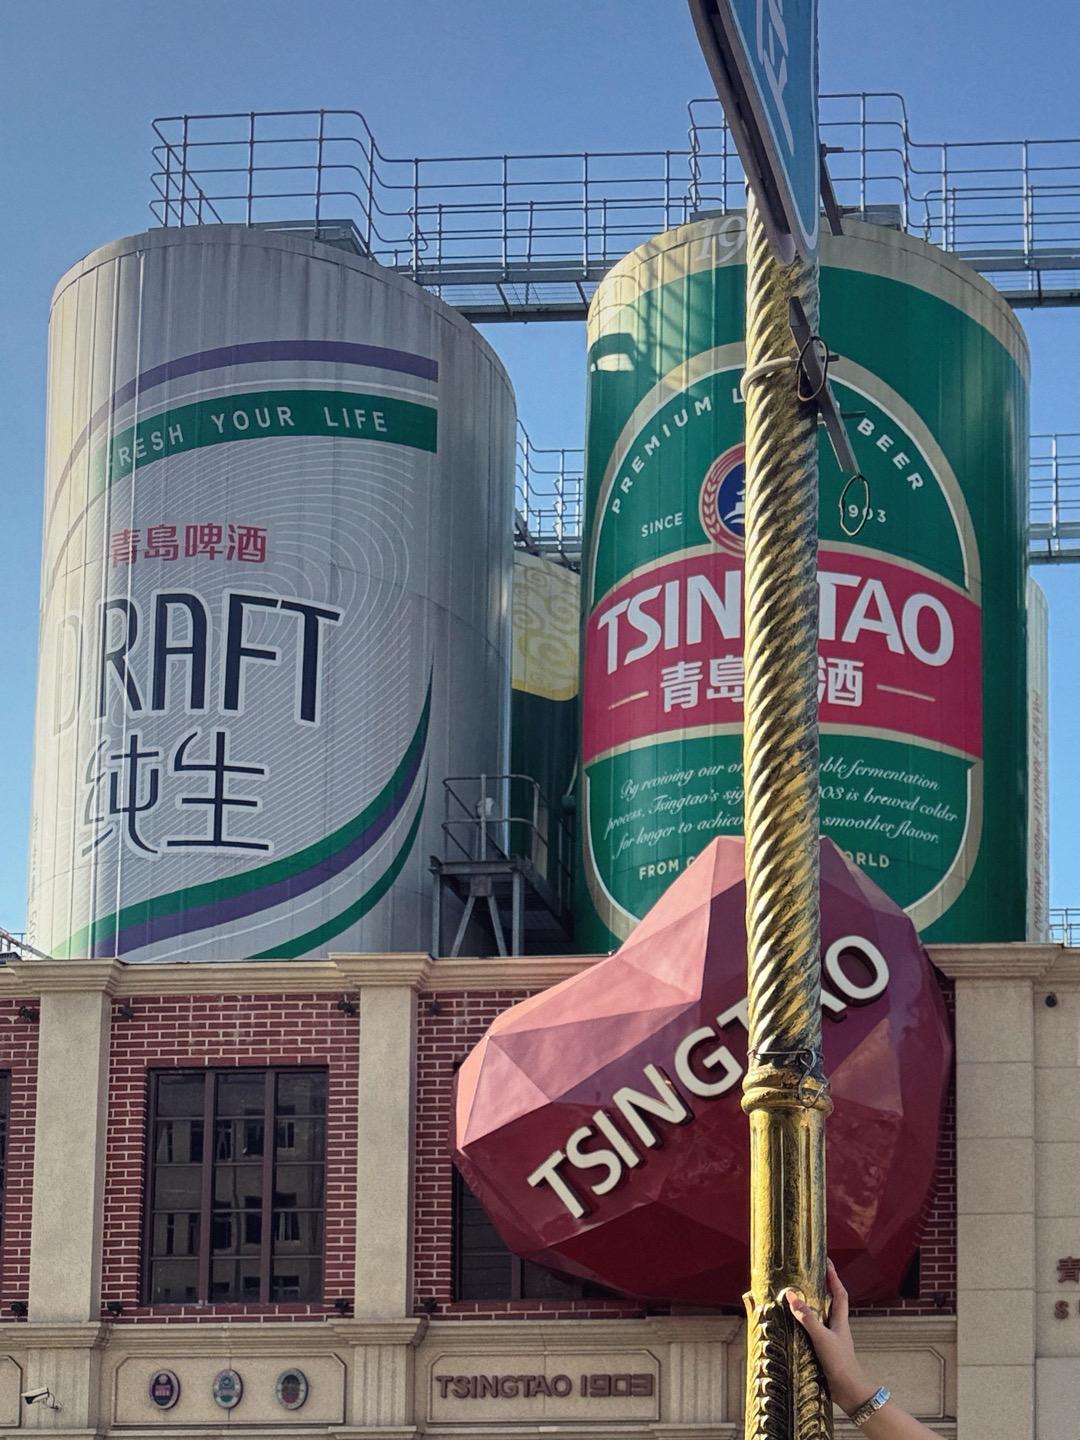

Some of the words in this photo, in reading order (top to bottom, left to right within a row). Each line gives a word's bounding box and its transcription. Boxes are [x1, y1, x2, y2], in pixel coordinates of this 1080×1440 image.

[117, 424, 184, 467] RESH
[211, 407, 295, 434] YOUR
[323, 406, 388, 432] LIFE
[611, 396, 712, 513] PREMIUM
[857, 418, 924, 490] BEER
[641, 513, 683, 538] SINCE
[848, 504, 887, 524] 903
[111, 522, 268, 568] 青島啤酒
[597, 570, 954, 675] TSINTAO
[661, 655, 864, 713] 青島酒
[82, 732, 272, 857] 纯生
[641, 768, 694, 792] reviving
[698, 764, 725, 777] our
[838, 759, 940, 791] fermentation
[822, 814, 896, 834] smoother
[846, 788, 860, 801] is
[864, 787, 921, 811] brewed
[919, 802, 958, 823] colder
[611, 832, 635, 861] for
[636, 825, 676, 847] longer
[677, 819, 693, 834] to
[697, 811, 744, 830] achiev
[639, 858, 680, 881] FROM
[527, 935, 891, 1220] TSINGO
[436, 1373, 572, 1401] TSINGTAO
[580, 1373, 655, 1399] 1903
